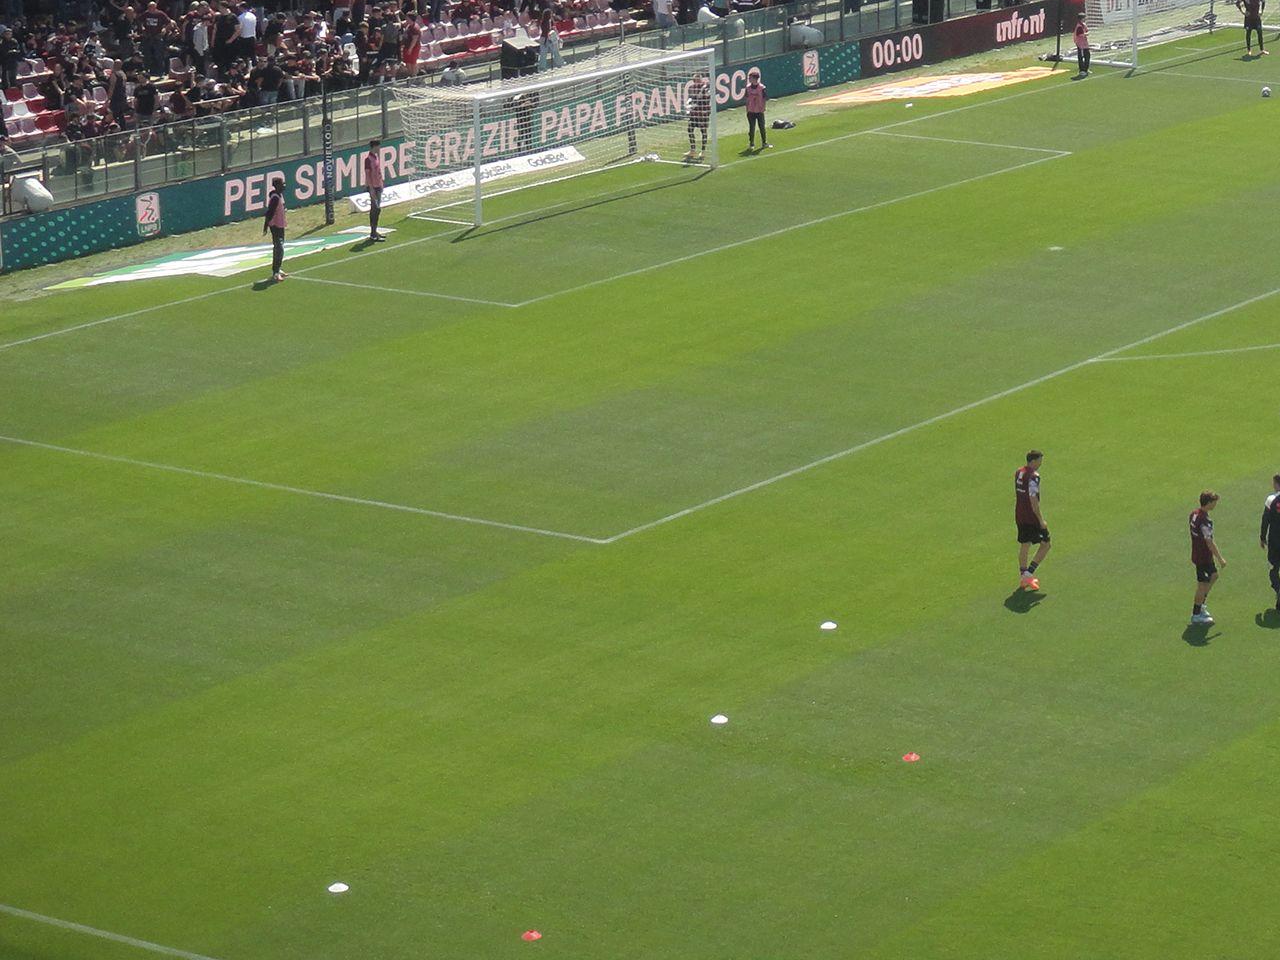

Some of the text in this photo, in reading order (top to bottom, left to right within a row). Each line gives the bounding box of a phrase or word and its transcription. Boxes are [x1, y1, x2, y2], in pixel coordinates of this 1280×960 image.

[872, 33, 923, 69] 00:00
[424, 117, 520, 169] GRAZIE
[540, 100, 609, 144] PAPA
[614, 66, 762, 130] FRANCSCO
